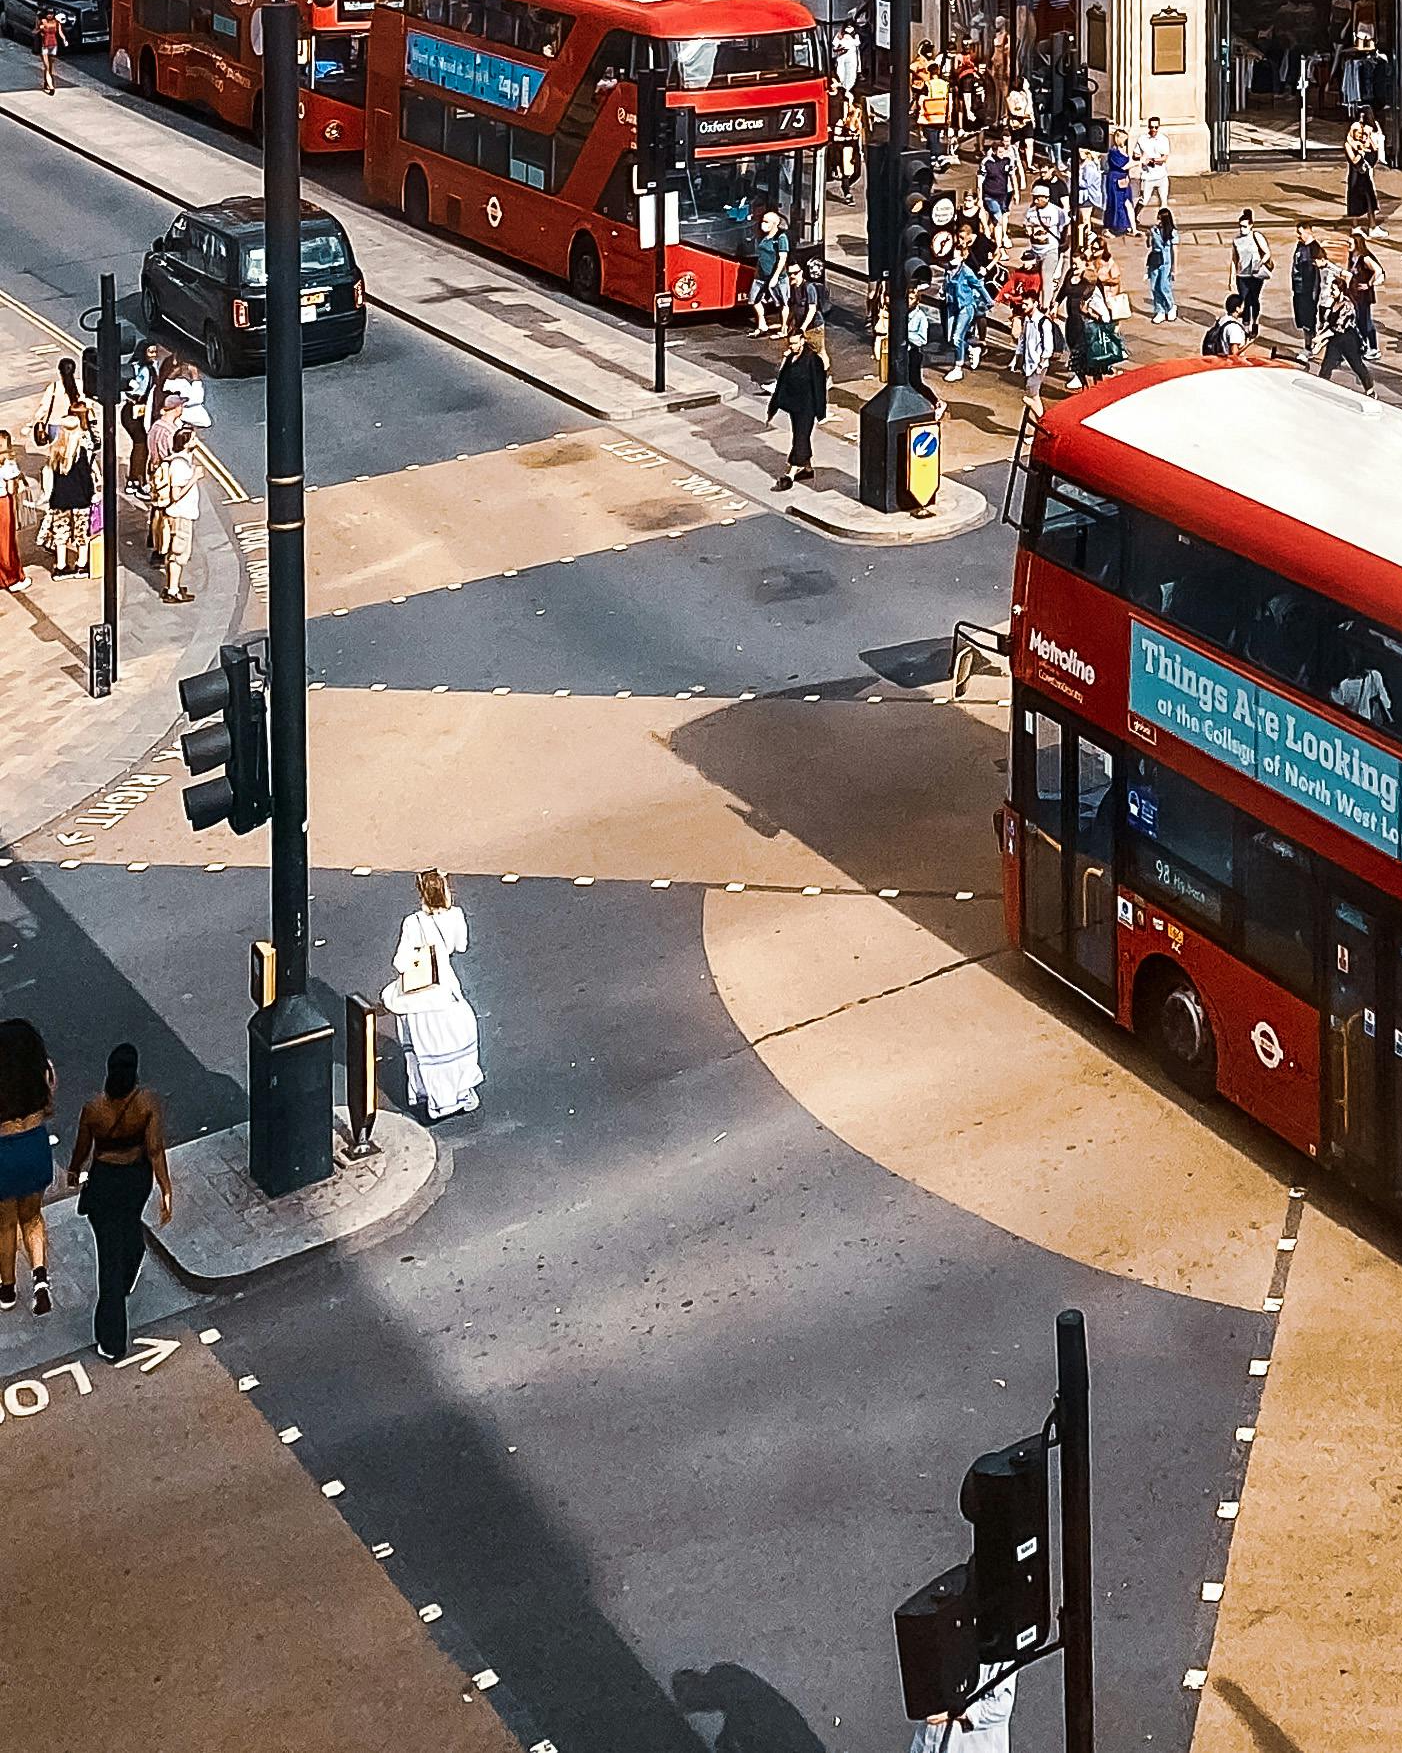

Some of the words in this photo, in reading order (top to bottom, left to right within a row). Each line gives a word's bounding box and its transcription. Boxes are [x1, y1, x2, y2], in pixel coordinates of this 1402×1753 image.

[699, 119, 733, 134] Oxford
[735, 117, 764, 131] Circus
[778, 108, 806, 130] 73
[600, 440, 671, 469] LEFT
[1029, 627, 1096, 685] Metroline
[1141, 638, 1228, 712] Things
[1233, 687, 1280, 741] Are
[1285, 713, 1399, 813] Looking
[1156, 698, 1172, 717] at
[1175, 704, 1199, 735] the
[1202, 719, 1256, 765] College
[1263, 754, 1281, 776] of
[1285, 762, 1331, 806] North
[1335, 795, 1378, 832] West
[74, 773, 173, 831] RIGHT
[1155, 859, 1171, 885] 98
